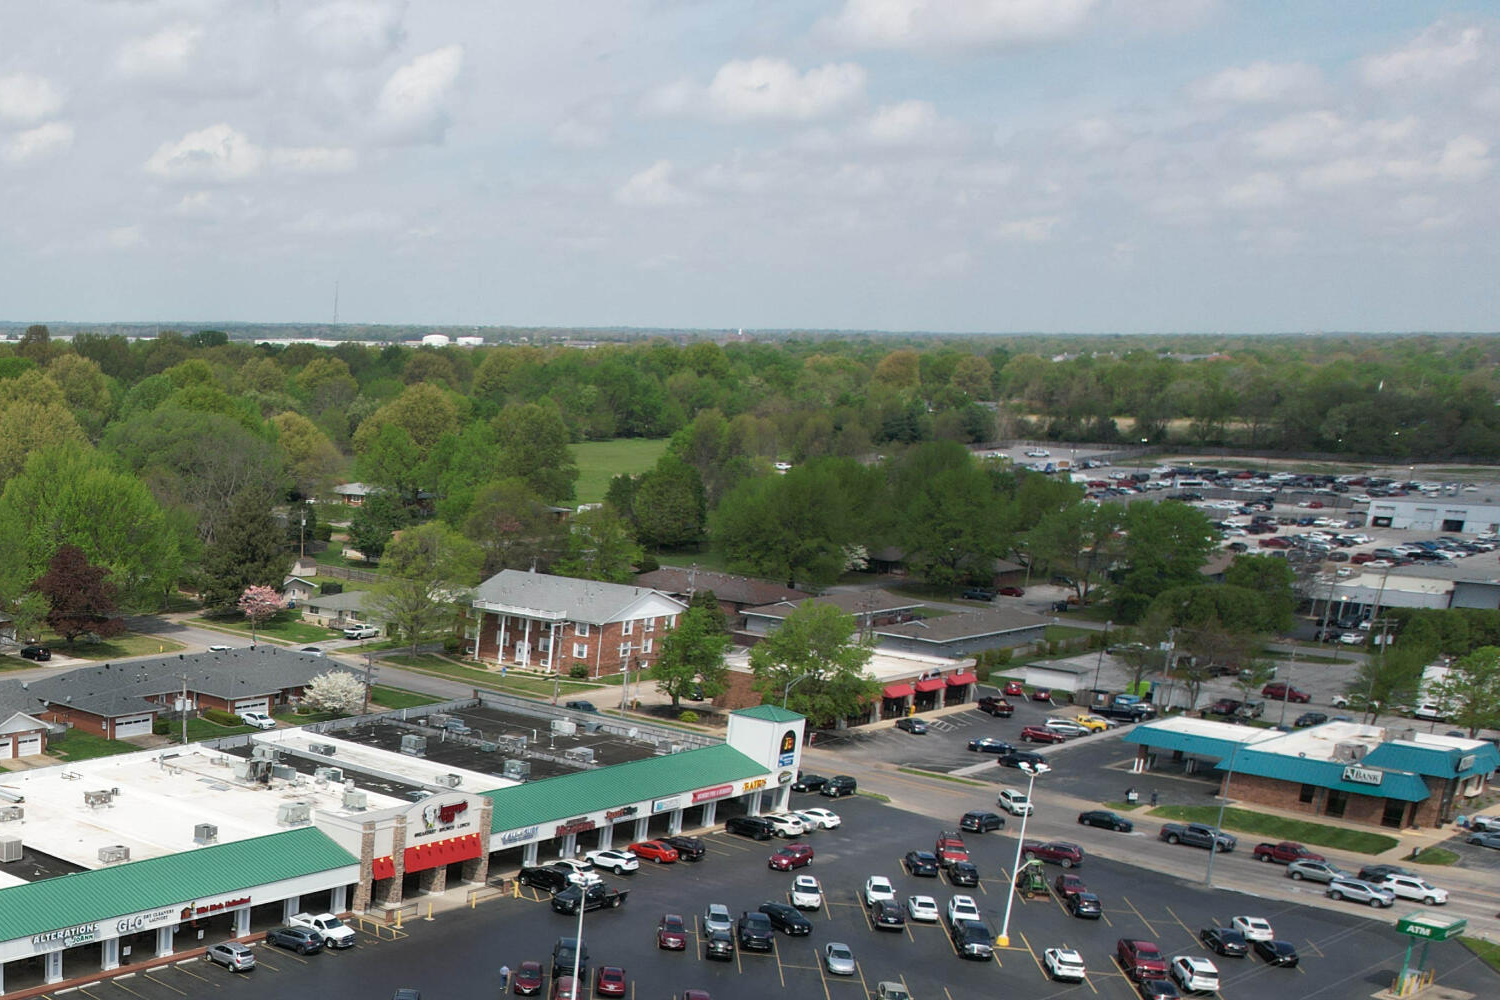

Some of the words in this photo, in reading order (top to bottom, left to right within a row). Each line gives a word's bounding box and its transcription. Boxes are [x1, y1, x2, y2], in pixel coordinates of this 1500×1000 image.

[117, 916, 143, 933] GLO
[1406, 925, 1431, 936] ATM
[33, 923, 100, 944] ALTERATIONS
